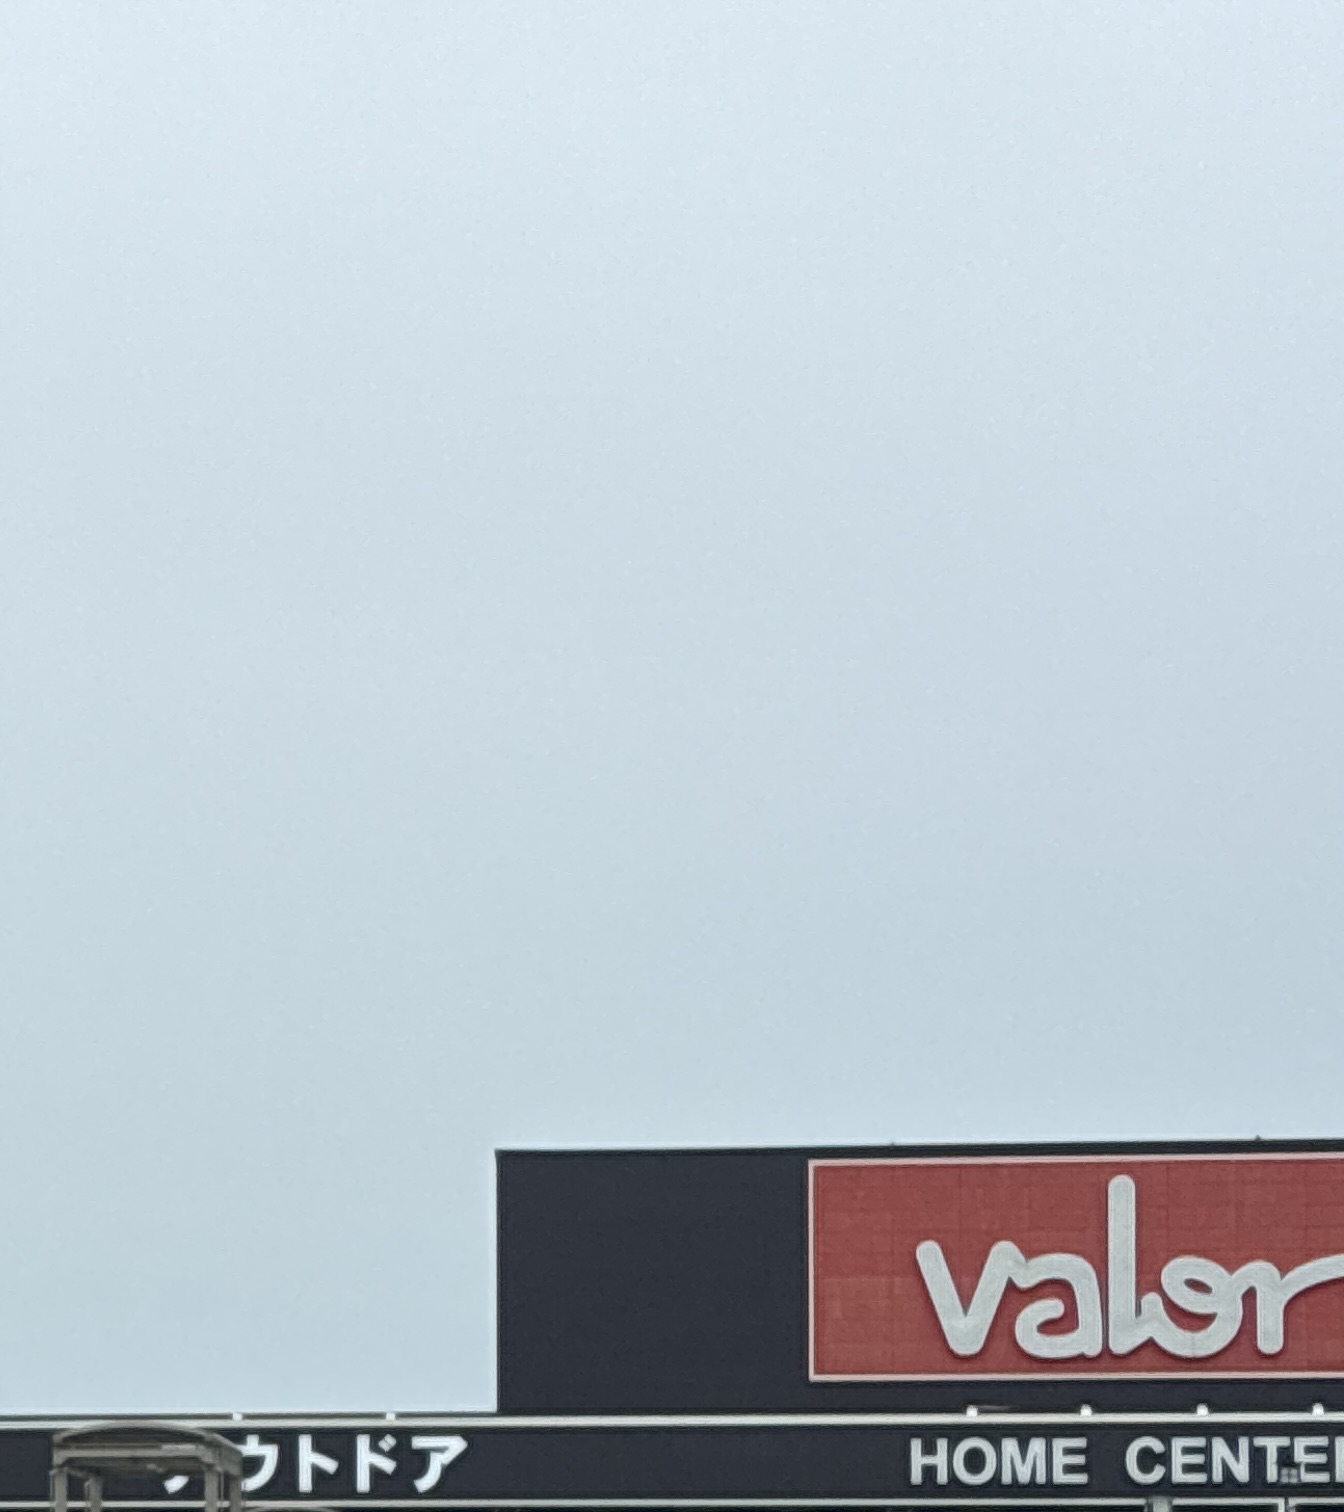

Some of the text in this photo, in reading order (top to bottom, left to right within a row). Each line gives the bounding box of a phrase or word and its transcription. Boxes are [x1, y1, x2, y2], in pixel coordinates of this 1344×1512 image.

[916, 1174, 1344, 1359] valor
[162, 1433, 468, 1494] ウトドア
[911, 1436, 1344, 1485] HOME CENTE
